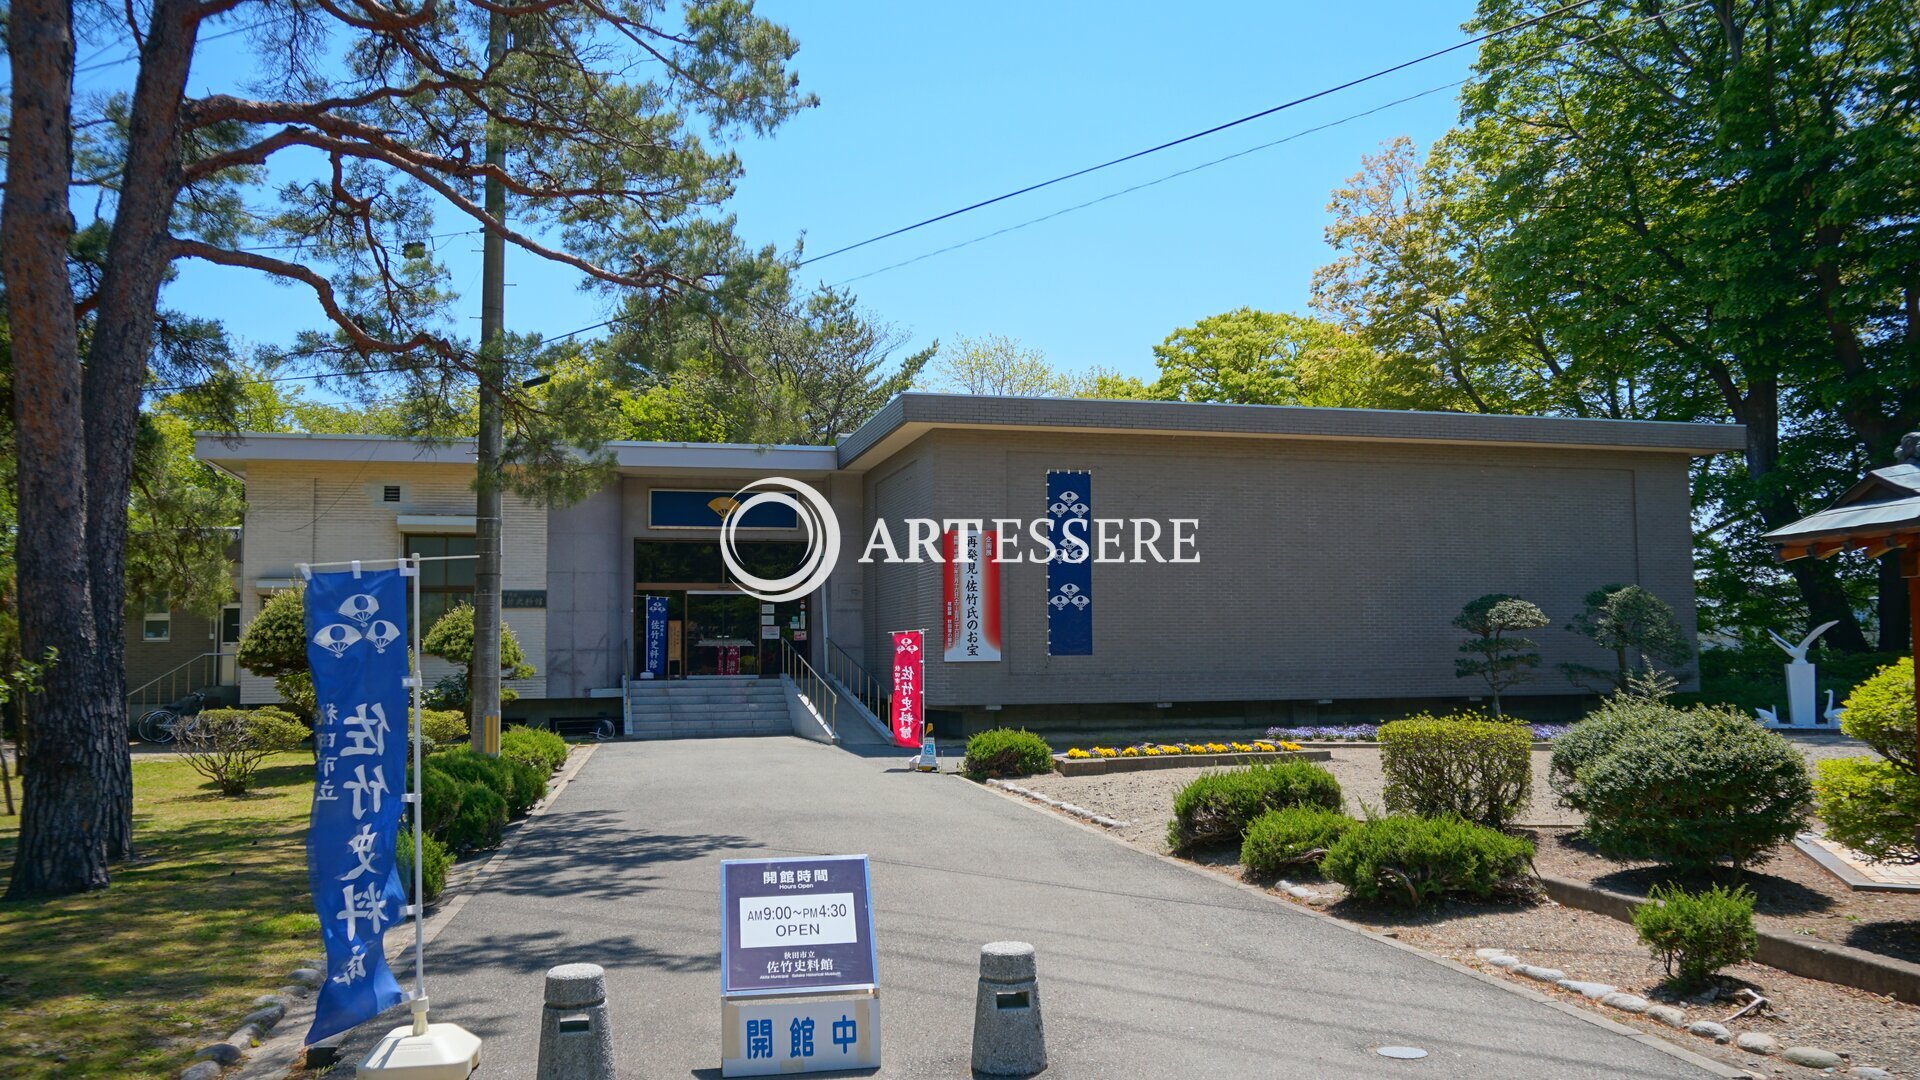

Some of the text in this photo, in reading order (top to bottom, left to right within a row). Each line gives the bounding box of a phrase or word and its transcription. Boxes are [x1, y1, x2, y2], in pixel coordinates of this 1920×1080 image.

[763, 869, 828, 884] 開館時間
[775, 923, 820, 937] OPEN
[784, 950, 815, 960] 秋田市立
[766, 958, 833, 974] 佐竹史料館
[746, 1014, 857, 1060] 開館中
